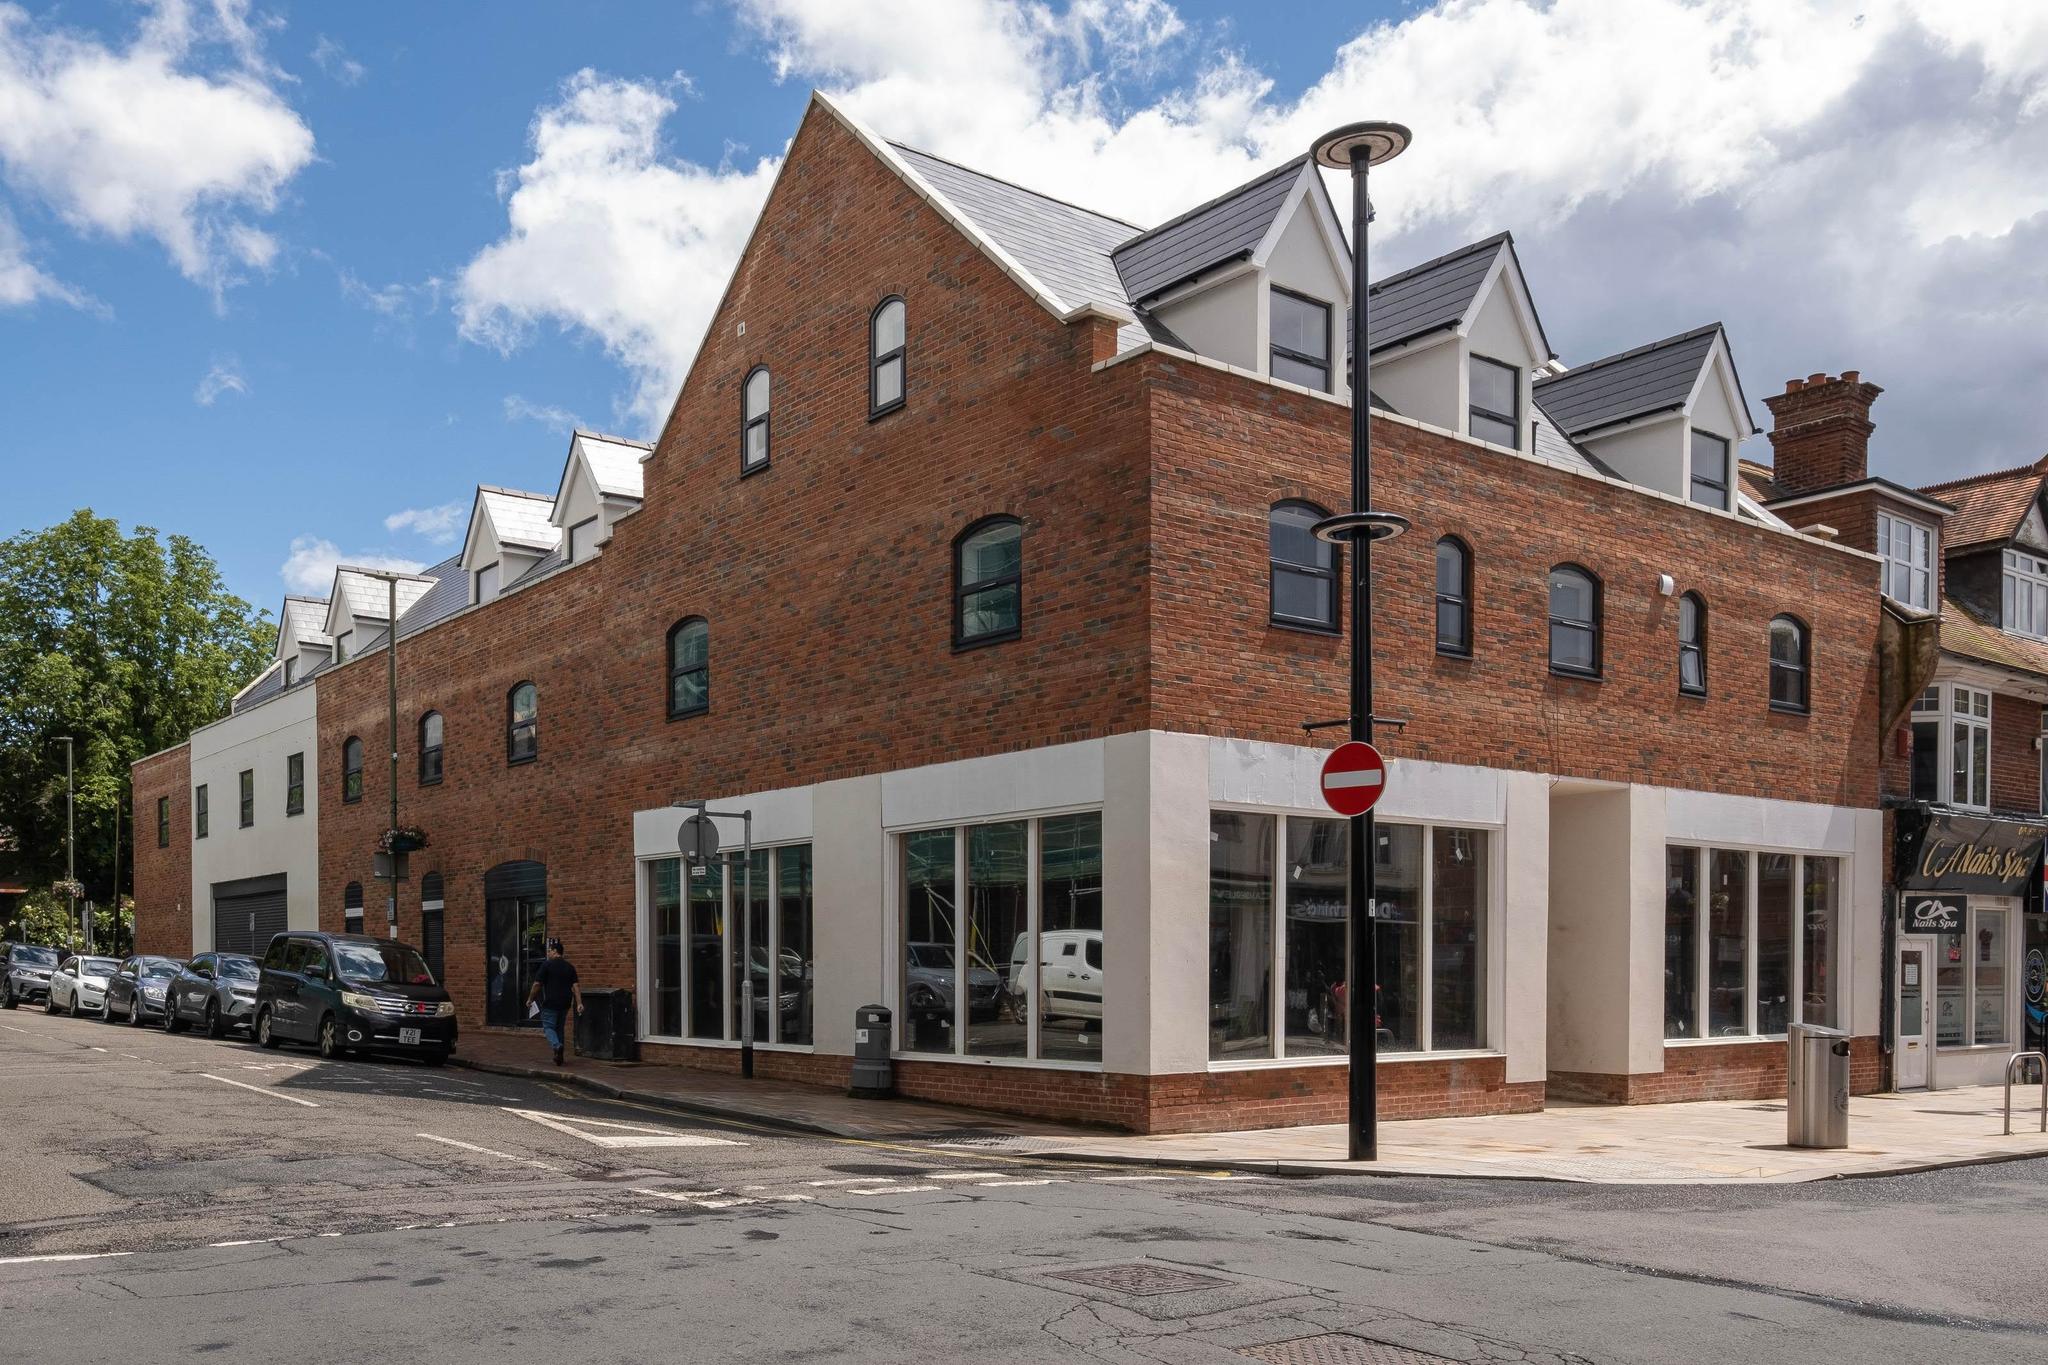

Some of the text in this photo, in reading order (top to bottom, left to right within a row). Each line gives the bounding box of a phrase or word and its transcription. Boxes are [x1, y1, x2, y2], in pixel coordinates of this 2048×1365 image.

[1999, 847, 2032, 884] Spa
[1914, 900, 1958, 920] CA
[1912, 918, 1958, 930] Nails Spa
